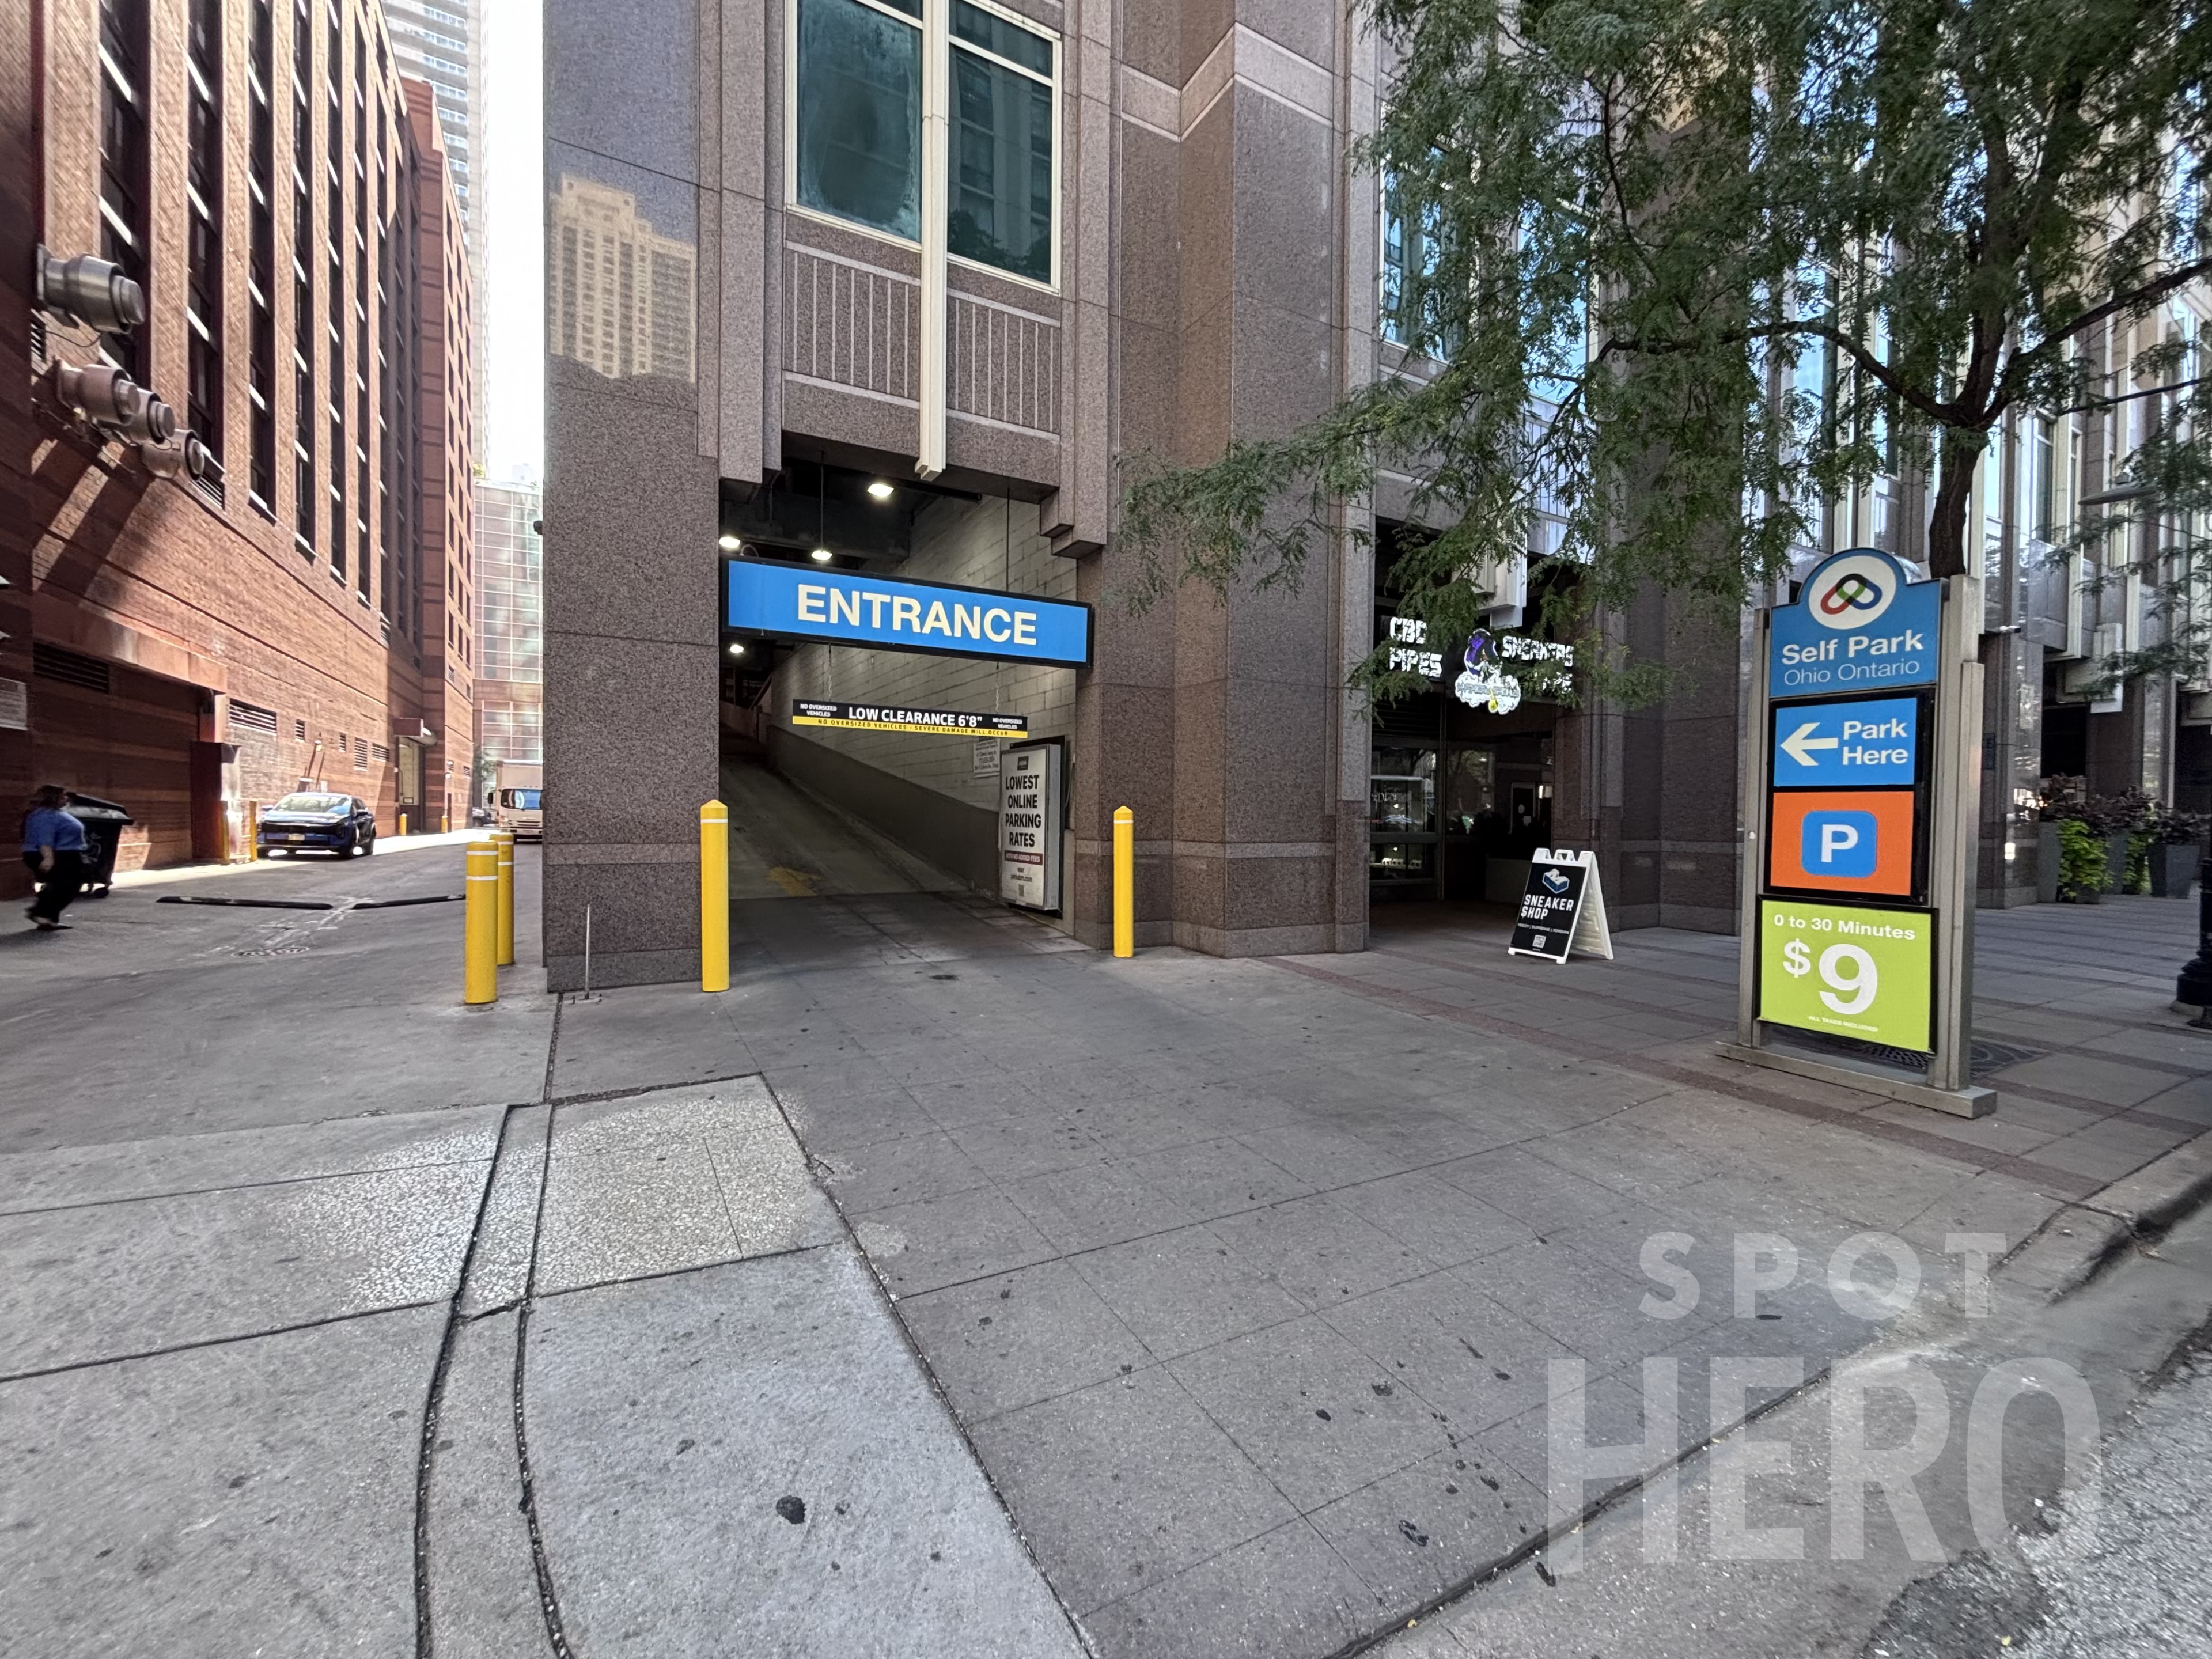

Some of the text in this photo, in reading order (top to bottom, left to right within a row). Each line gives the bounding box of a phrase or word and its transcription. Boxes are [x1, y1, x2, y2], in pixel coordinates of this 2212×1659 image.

[797, 584, 1036, 645] ENTRANCE
[1782, 629, 1923, 665] Self Park
[1389, 647, 1442, 677] PIPES
[1785, 658, 1919, 685] Ohio Ontario
[831, 719, 871, 728] OVERSIZED
[849, 707, 982, 727] LOW CLEARANCE 6'8"
[1843, 718, 1908, 740] Park
[1843, 746, 1908, 766] Here
[1006, 775, 1039, 790] LOWEST
[1008, 794, 1037, 809] ONLINE
[1005, 813, 1041, 828] PARKING
[1009, 832, 1035, 847] RATES
[1821, 824, 1859, 863] P
[1524, 894, 1574, 911] SNEAKER
[1521, 906, 1548, 920] SHOP
[1774, 914, 1915, 940] 0 to 30 Minutes
